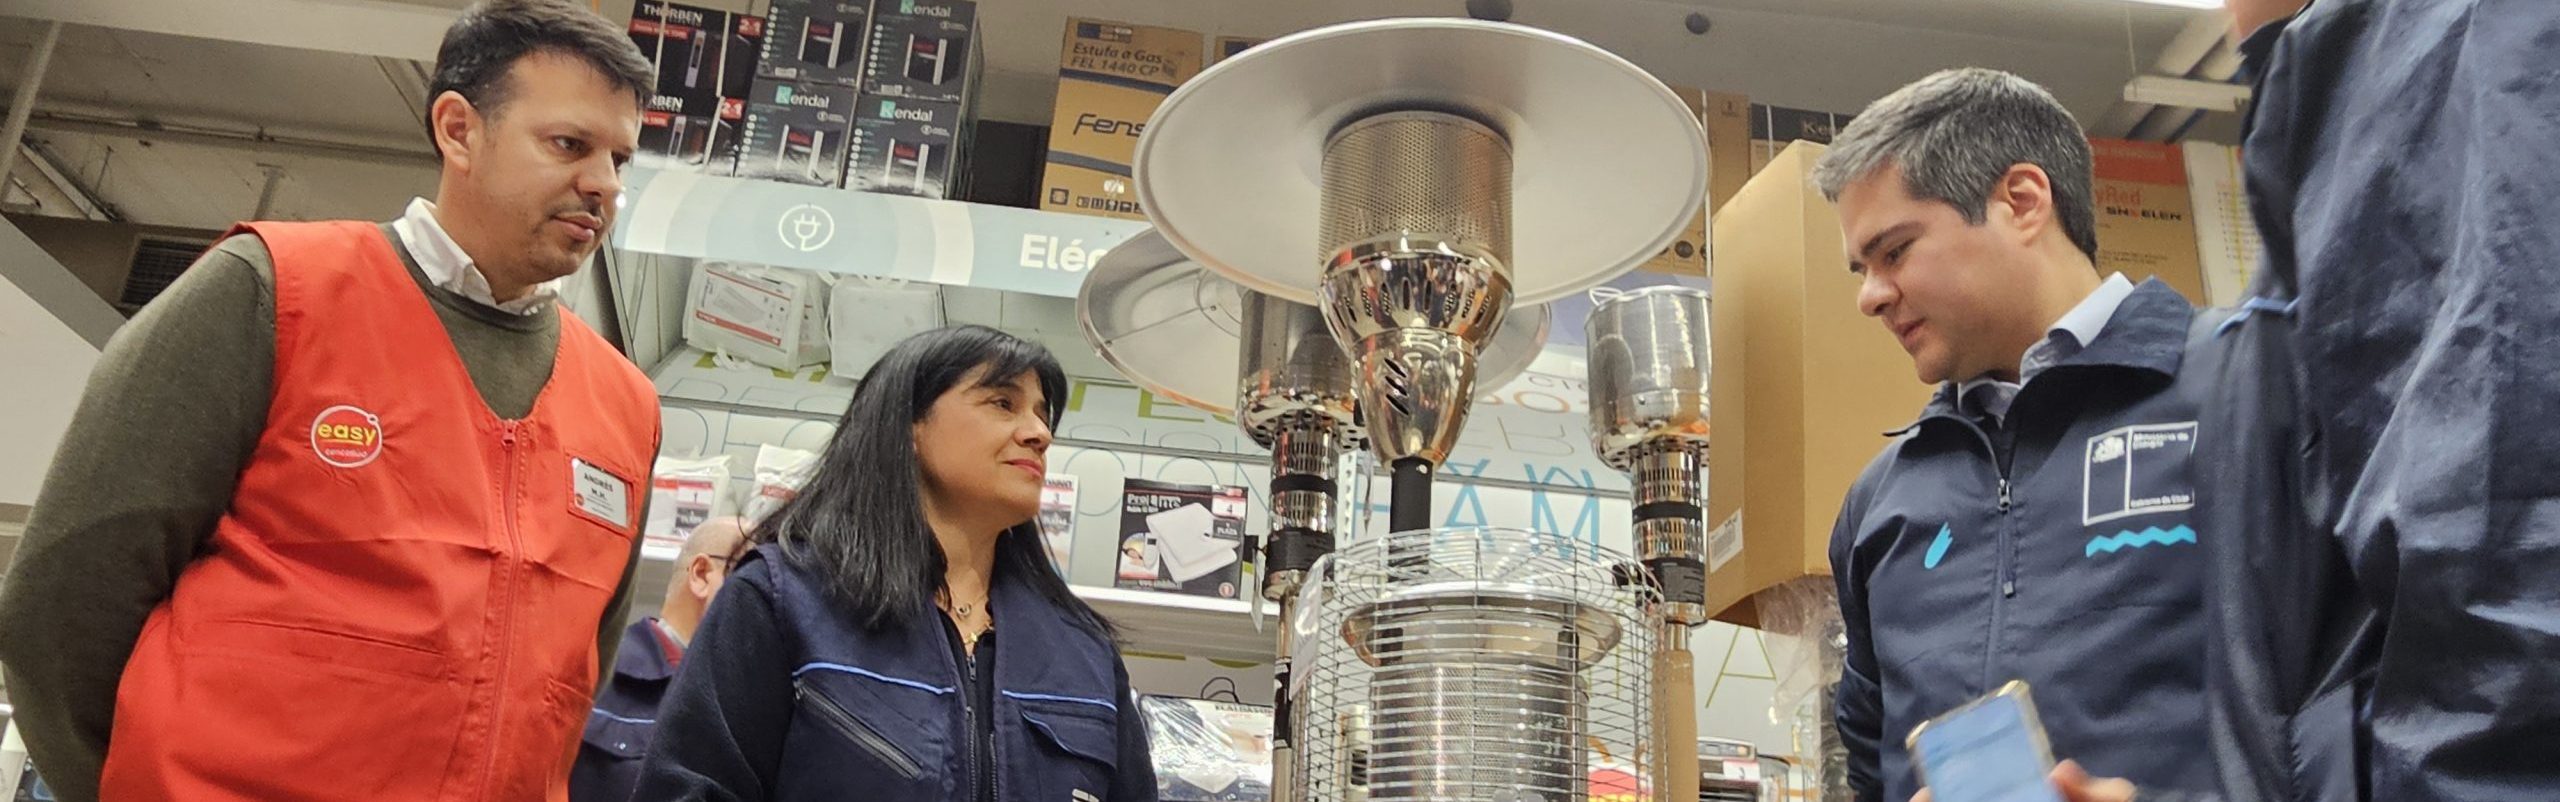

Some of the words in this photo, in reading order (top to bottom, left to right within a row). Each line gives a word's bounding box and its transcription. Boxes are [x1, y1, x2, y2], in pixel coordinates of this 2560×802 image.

[1073, 42, 1118, 59] Estufa
[1121, 51, 1131, 59] a
[1134, 50, 1162, 64] Gas
[1071, 57, 1094, 68] FEL
[1102, 61, 1136, 74] 1440
[1139, 66, 1160, 77] CP
[775, 86, 830, 109] Kendal
[879, 100, 934, 122] Kendal
[318, 424, 376, 446] easy
